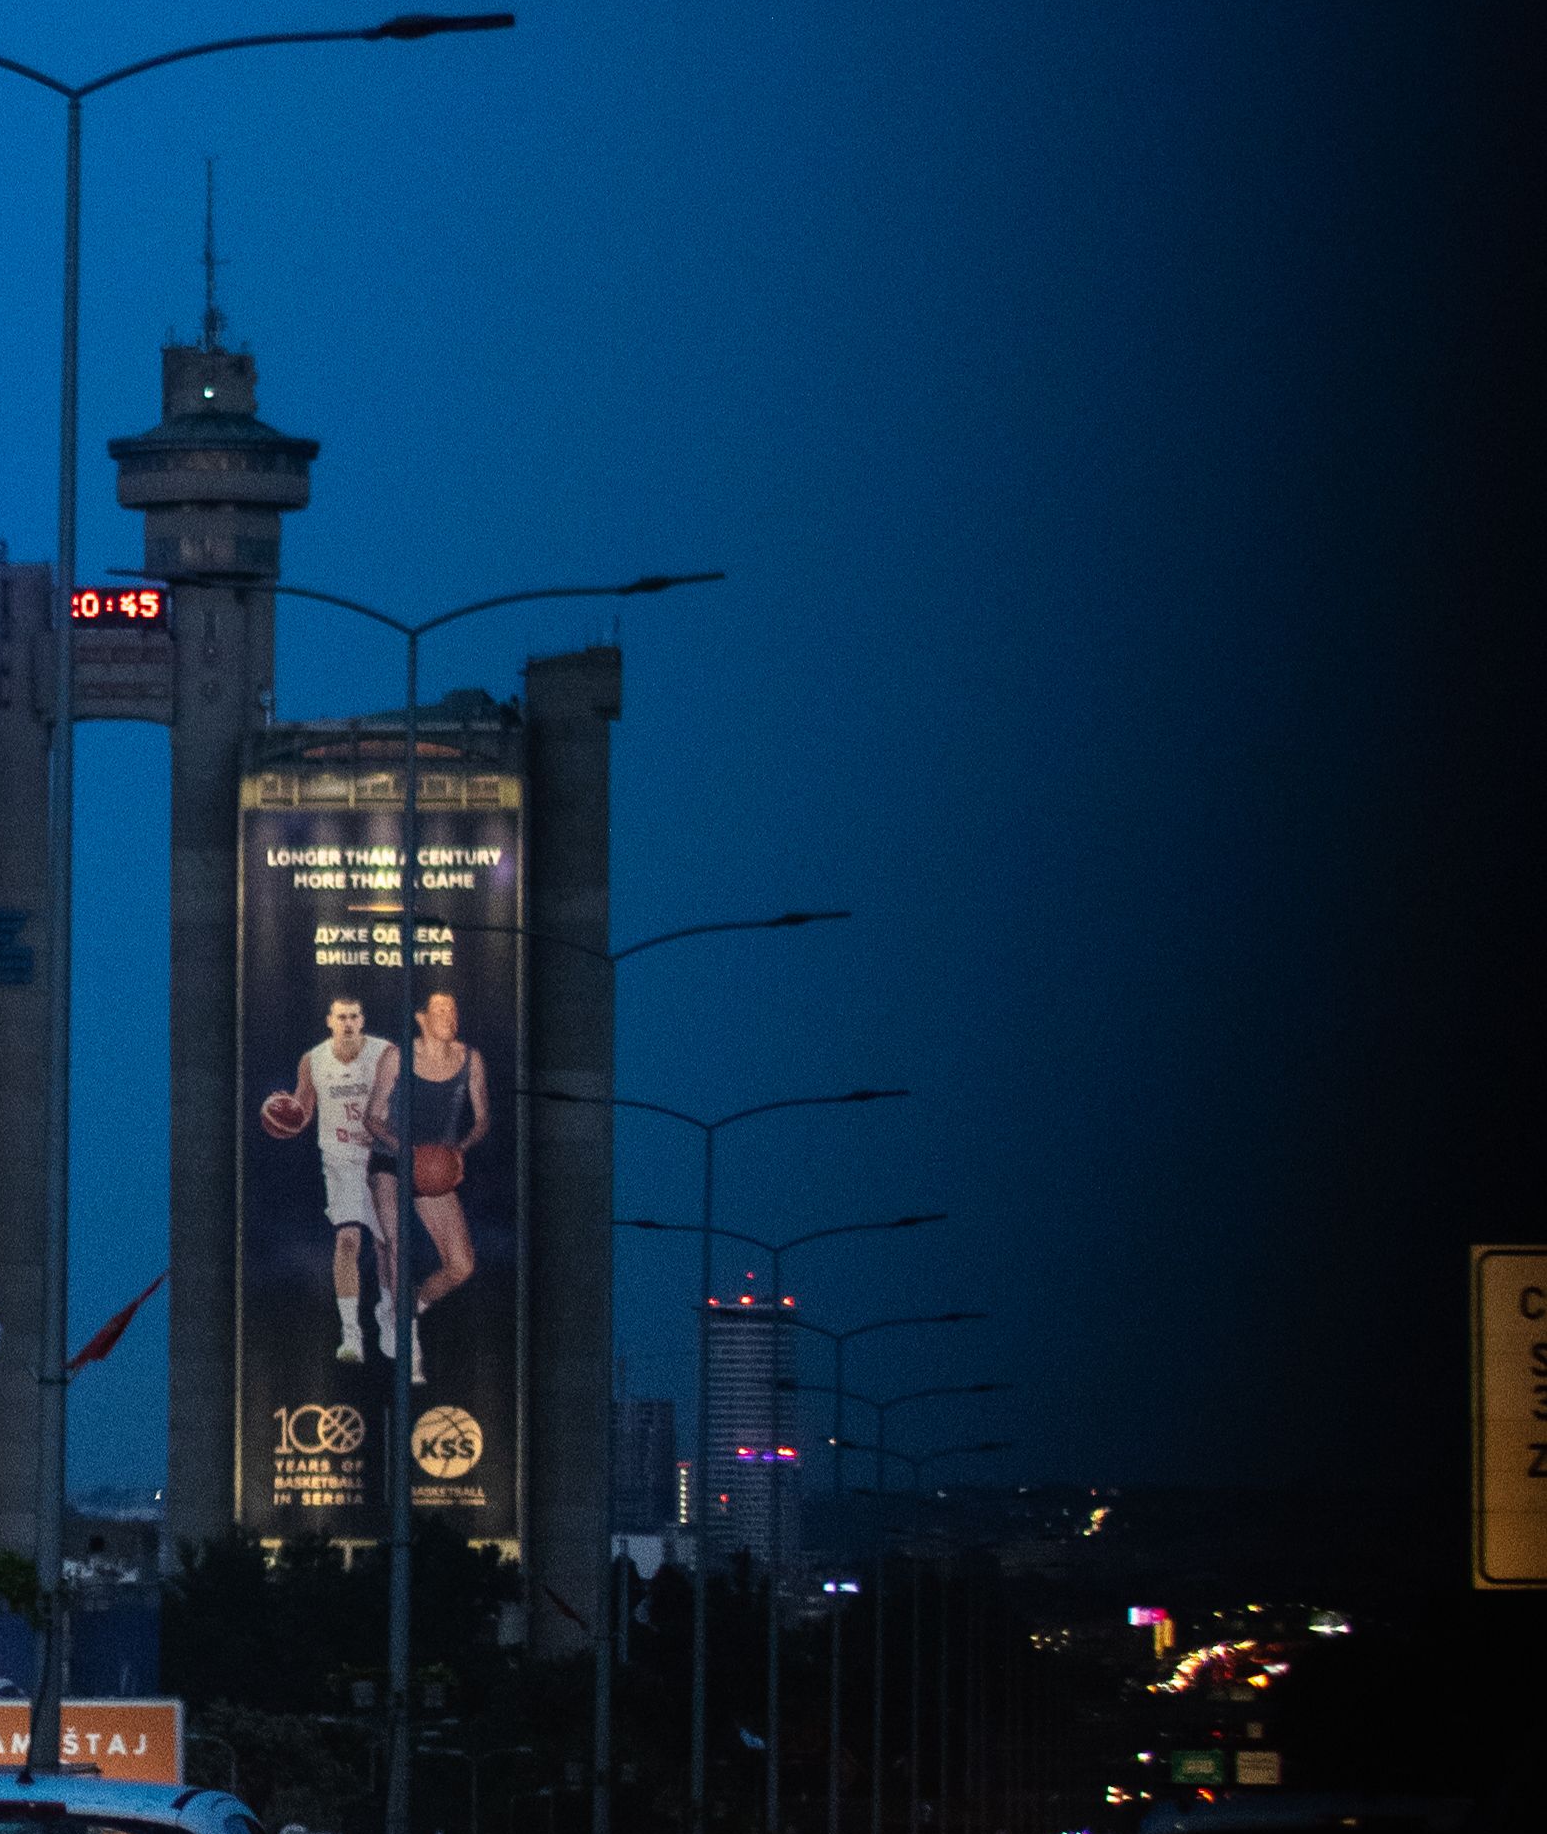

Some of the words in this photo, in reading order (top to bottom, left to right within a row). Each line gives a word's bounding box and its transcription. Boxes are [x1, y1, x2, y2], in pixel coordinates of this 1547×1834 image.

[266, 848, 341, 867] LONGER
[345, 847, 397, 867] THAN
[417, 848, 502, 866] CENTURY
[293, 870, 347, 889] MORE
[350, 869, 402, 889] THAN
[422, 870, 476, 889] GAME
[314, 926, 370, 945] ДУЖЕ
[372, 925, 402, 945] ОД
[413, 926, 455, 944] ЕКА
[315, 949, 371, 966] ВИШЕ
[374, 949, 405, 968] ОД
[419, 1437, 475, 1460] KSS
[275, 1459, 331, 1473] YEARS
[274, 1476, 364, 1489] BASKETBALL
[301, 1492, 364, 1506] SERBIA
